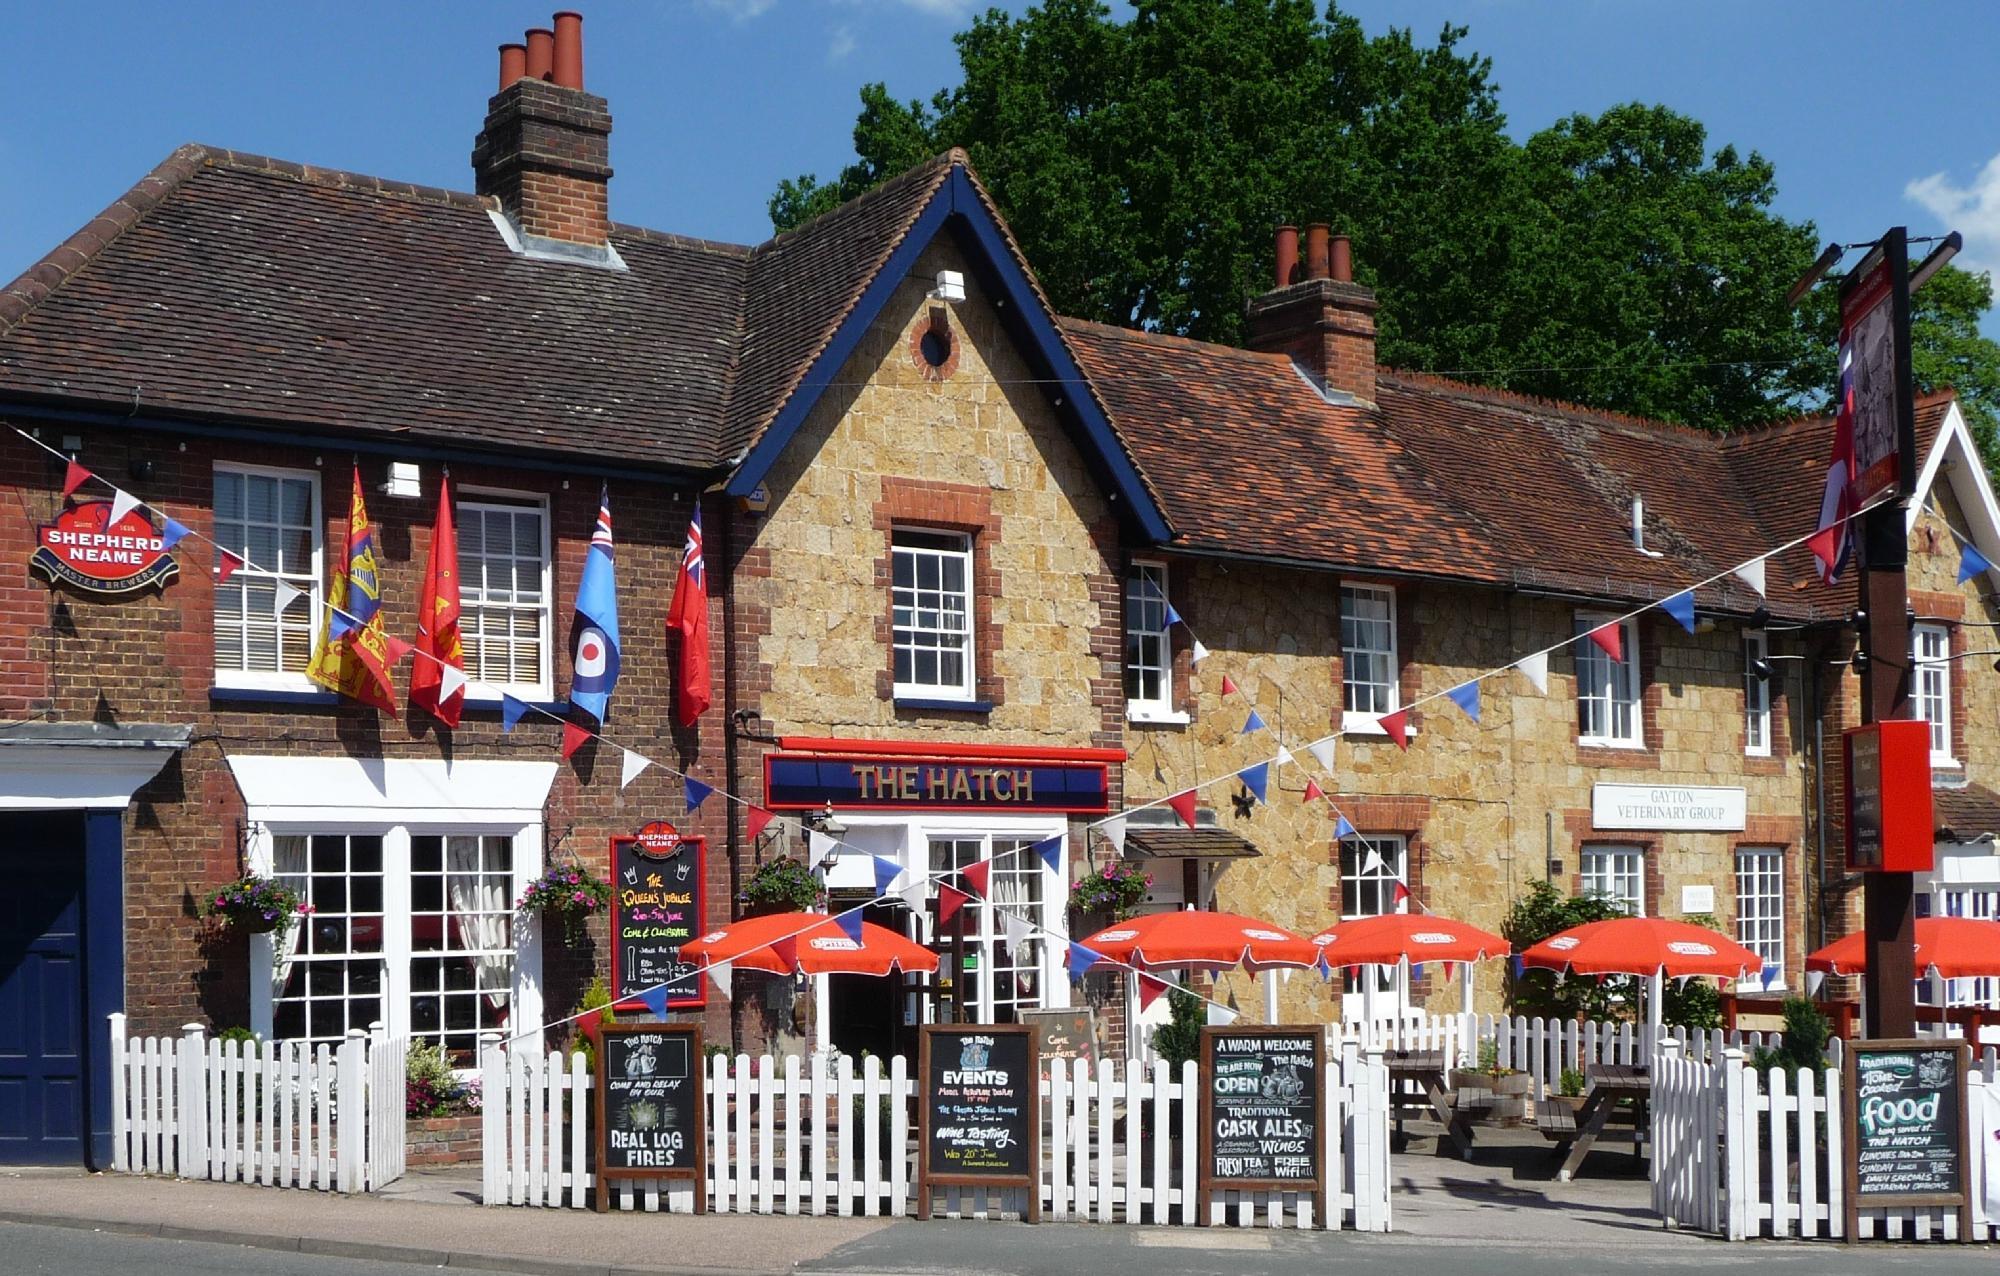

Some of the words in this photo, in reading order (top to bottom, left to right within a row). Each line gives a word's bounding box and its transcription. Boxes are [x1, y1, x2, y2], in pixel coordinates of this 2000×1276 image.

[48, 531, 163, 550] SHEPHERD
[70, 548, 142, 564] NEAME
[56, 562, 100, 587] MASTER
[106, 569, 155, 588] BREWERS
[852, 764, 919, 800] THE
[928, 767, 1033, 801] HATCH
[1651, 790, 1694, 803] GAYTON
[1618, 805, 1687, 819] VETERINARY
[1690, 807, 1725, 820] GROUP
[658, 892, 692, 909] JUBILEE
[1217, 1038, 1227, 1052] A
[1228, 1039, 1261, 1052] WARM
[1264, 1040, 1312, 1051] WELCOME
[1217, 1065, 1229, 1073] WE
[1229, 1062, 1243, 1072] ARE
[1244, 1062, 1263, 1071] NOW
[1859, 1057, 1915, 1068] TRADITIONAL
[610, 1081, 632, 1090] COME
[635, 1081, 650, 1089] AND
[652, 1080, 681, 1090] RELAX
[943, 1071, 1008, 1085] EVENTS
[1215, 1077, 1259, 1093] OPEN
[630, 1089, 642, 1097] BY
[644, 1089, 664, 1097] OUR
[1228, 1108, 1292, 1118] TRADITIONAL
[1862, 1093, 1940, 1132] food
[1217, 1119, 1259, 1138] CASK
[1264, 1119, 1302, 1138] ALES
[611, 1129, 647, 1148] REAL
[654, 1131, 683, 1149] LOG
[936, 1127, 964, 1138] Wine
[967, 1126, 1010, 1148] Tasting
[1868, 1137, 1889, 1146] THE
[1892, 1136, 1931, 1146] HATCH
[1259, 1139, 1306, 1155] Wines
[627, 1150, 675, 1166] FIRES
[1274, 1158, 1310, 1166] FREE
[1217, 1158, 1243, 1177] FRESH
[1244, 1158, 1262, 1168] TEA
[1274, 1166, 1300, 1178] Wifi
[1859, 1163, 1894, 1174] SUNDAY
[1891, 1173, 1932, 1182] SPECIALS
